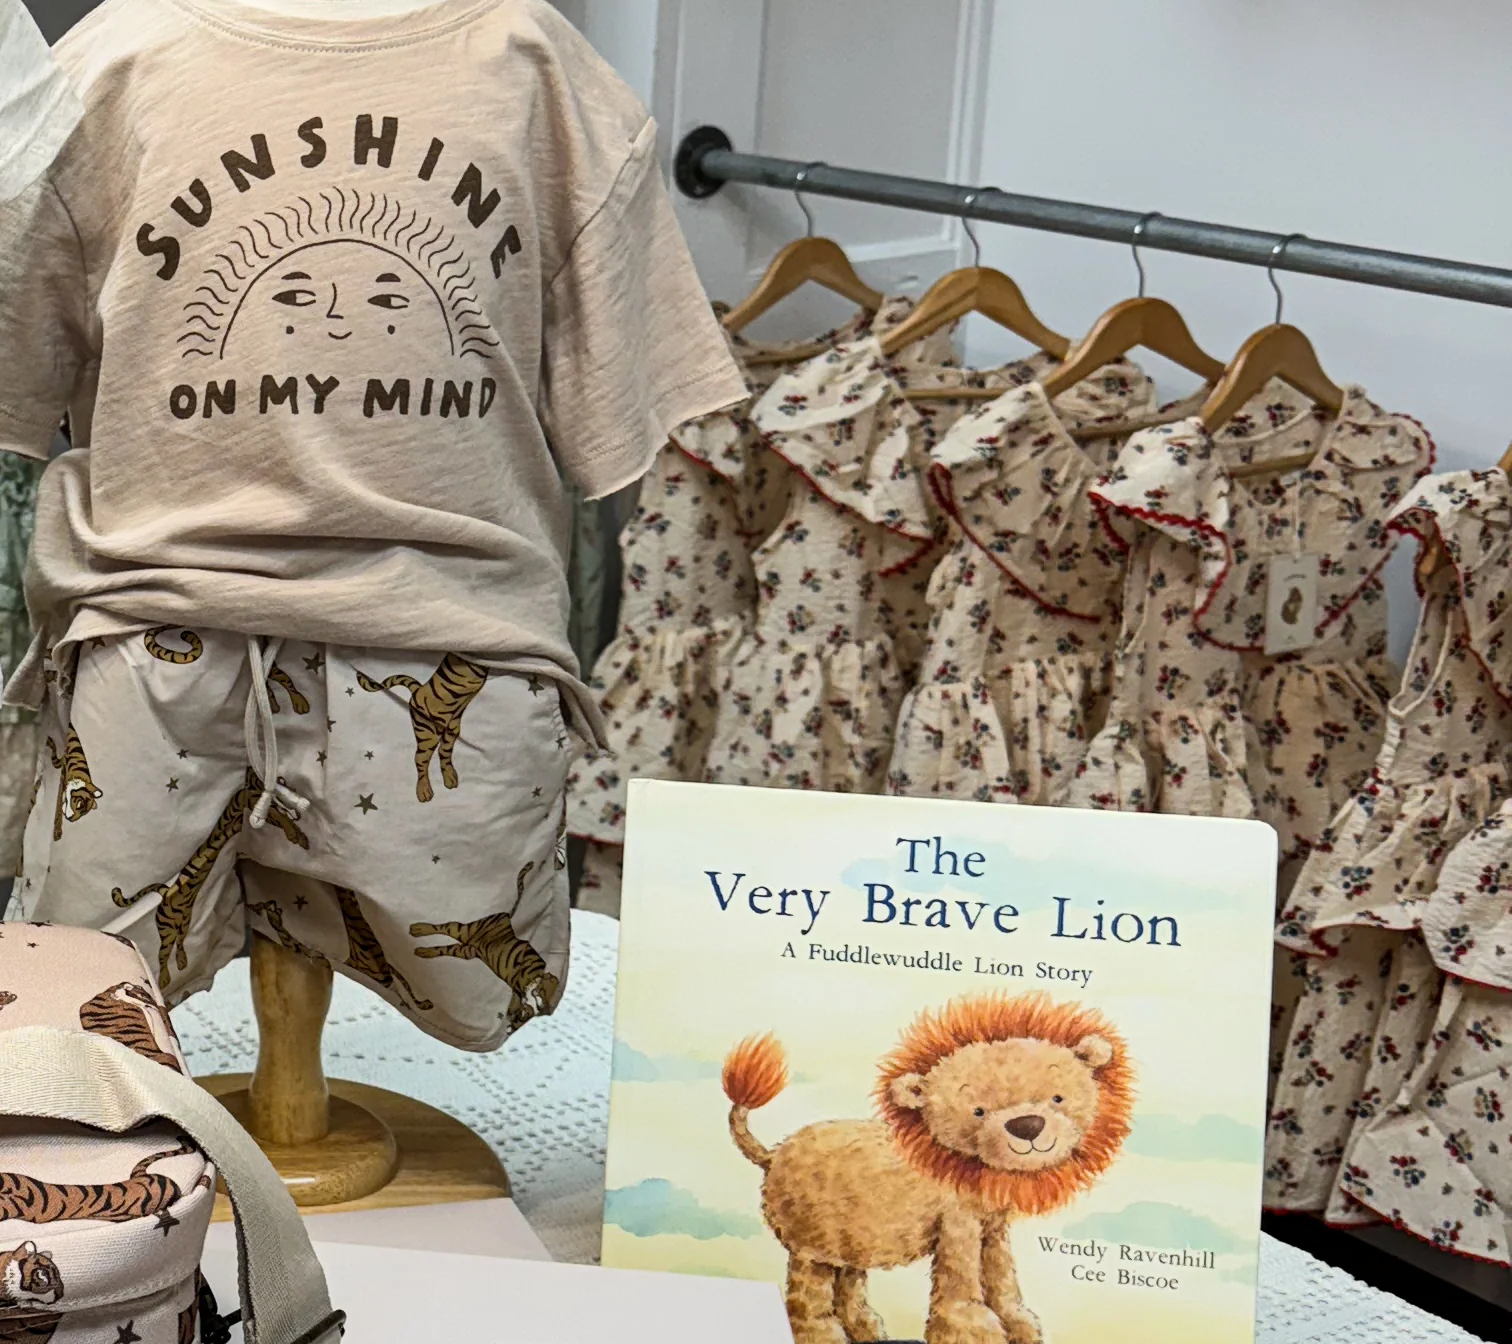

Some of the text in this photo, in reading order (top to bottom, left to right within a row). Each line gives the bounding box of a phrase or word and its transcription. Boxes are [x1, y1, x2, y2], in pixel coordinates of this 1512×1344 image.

[136, 114, 522, 280] SUNSHINE
[169, 374, 496, 419] ON MY MIND
[896, 836, 986, 877] The
[704, 870, 1182, 947] Very Brave Lion
[781, 942, 1094, 989] A Fuddlewuddle Lion Story
[1038, 1236, 1216, 1269] Wendy Ravenhill
[1071, 1264, 1180, 1290] Cee Biscoe
